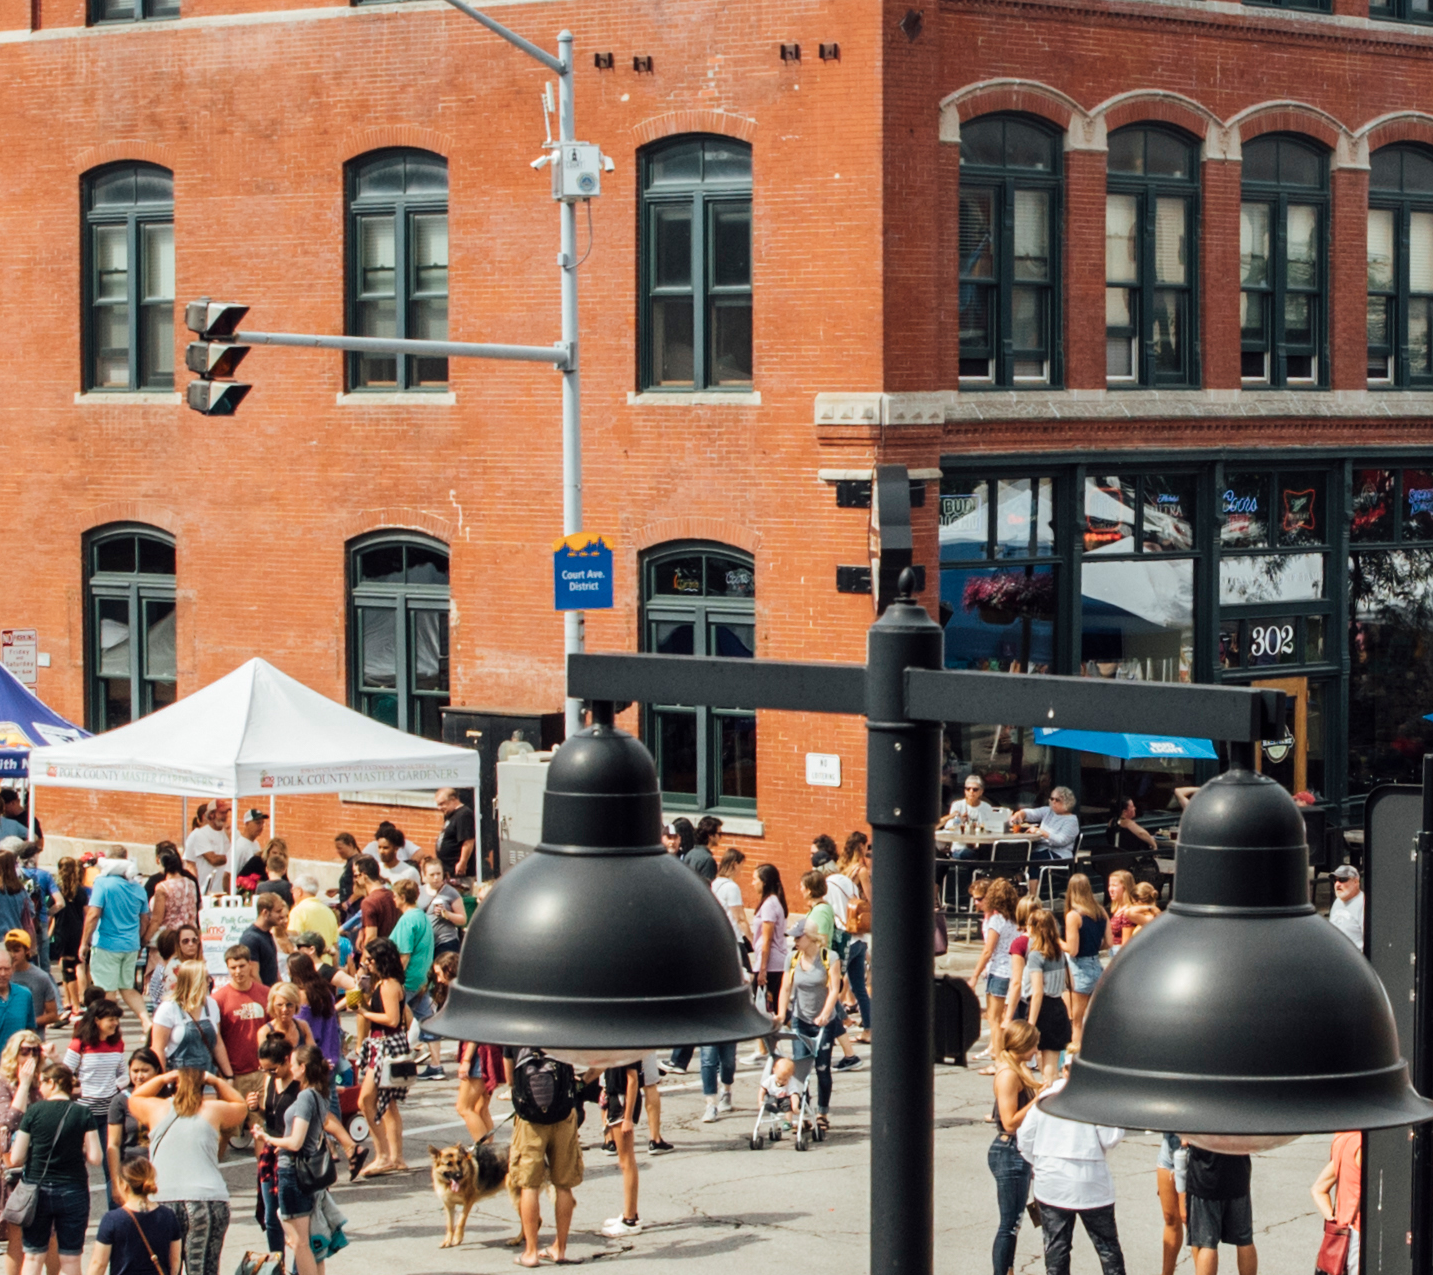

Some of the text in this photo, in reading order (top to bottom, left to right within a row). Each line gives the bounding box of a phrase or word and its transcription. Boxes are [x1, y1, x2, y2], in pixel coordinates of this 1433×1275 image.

[562, 570, 585, 580] Court
[568, 581, 599, 591] District
[1251, 625, 1294, 657] 302
[59, 768, 82, 779] POLK
[83, 768, 120, 780] COUNTY
[277, 768, 459, 787] POLK COUNTY MASTER GARDENERS
